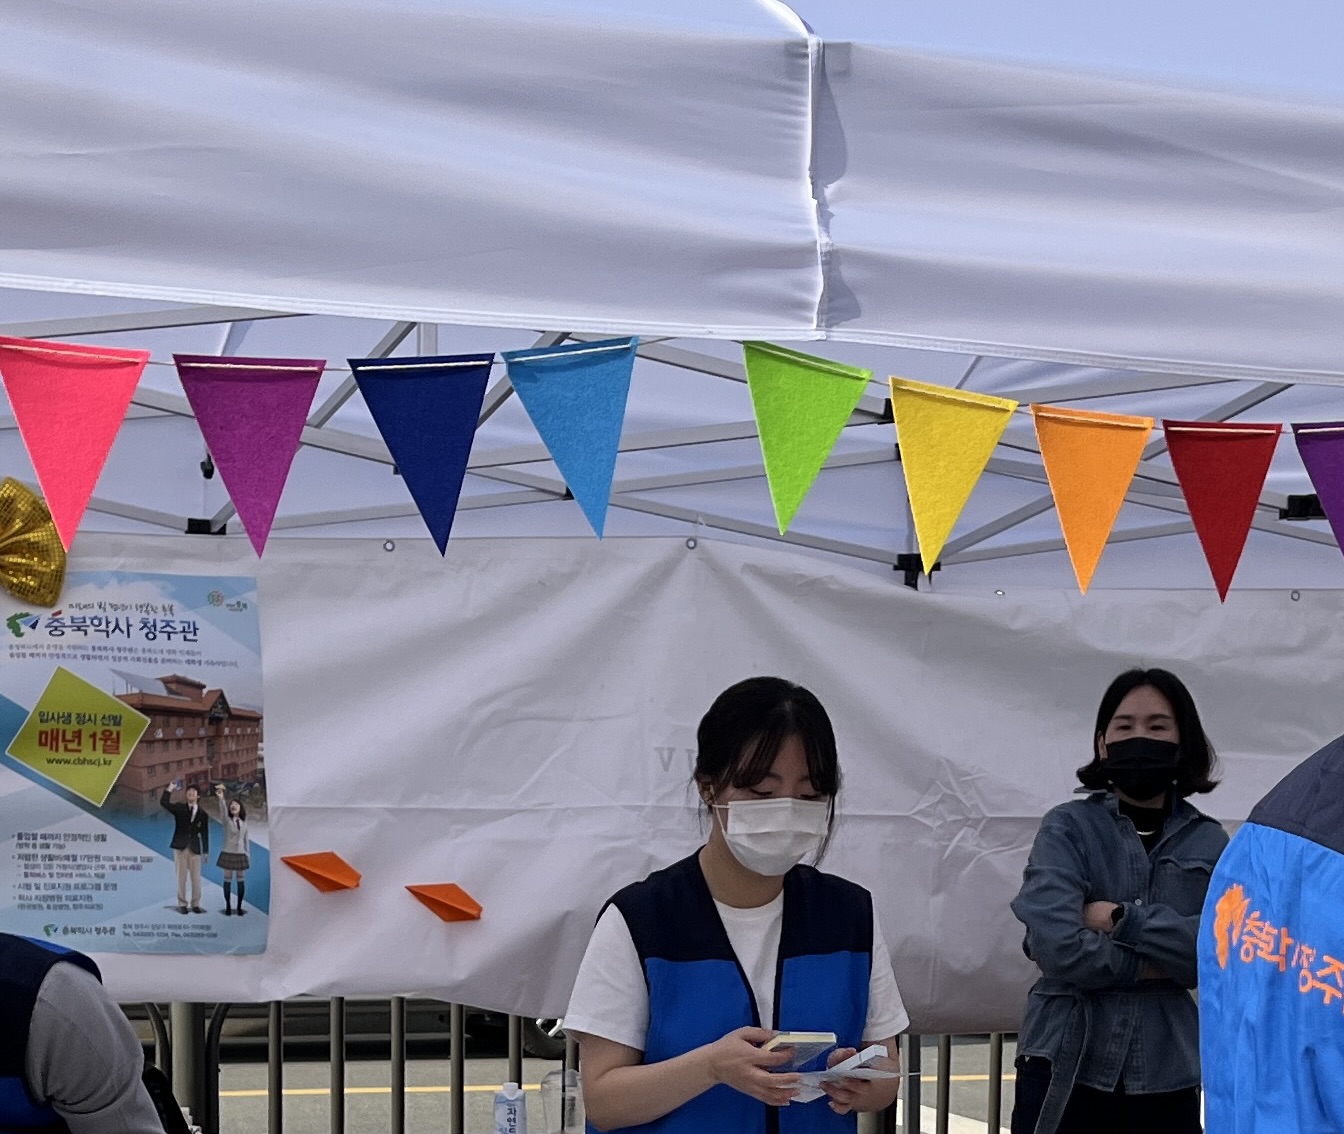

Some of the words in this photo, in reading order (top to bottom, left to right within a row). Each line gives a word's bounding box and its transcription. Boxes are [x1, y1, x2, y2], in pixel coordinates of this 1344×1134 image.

[44, 610, 133, 639] 충북학사
[139, 619, 199, 642] 청주관
[38, 711, 72, 726] 입사생
[75, 712, 97, 726] 정시
[100, 713, 122, 726] 선발
[38, 729, 83, 753] 매년
[89, 732, 121, 755] 1월
